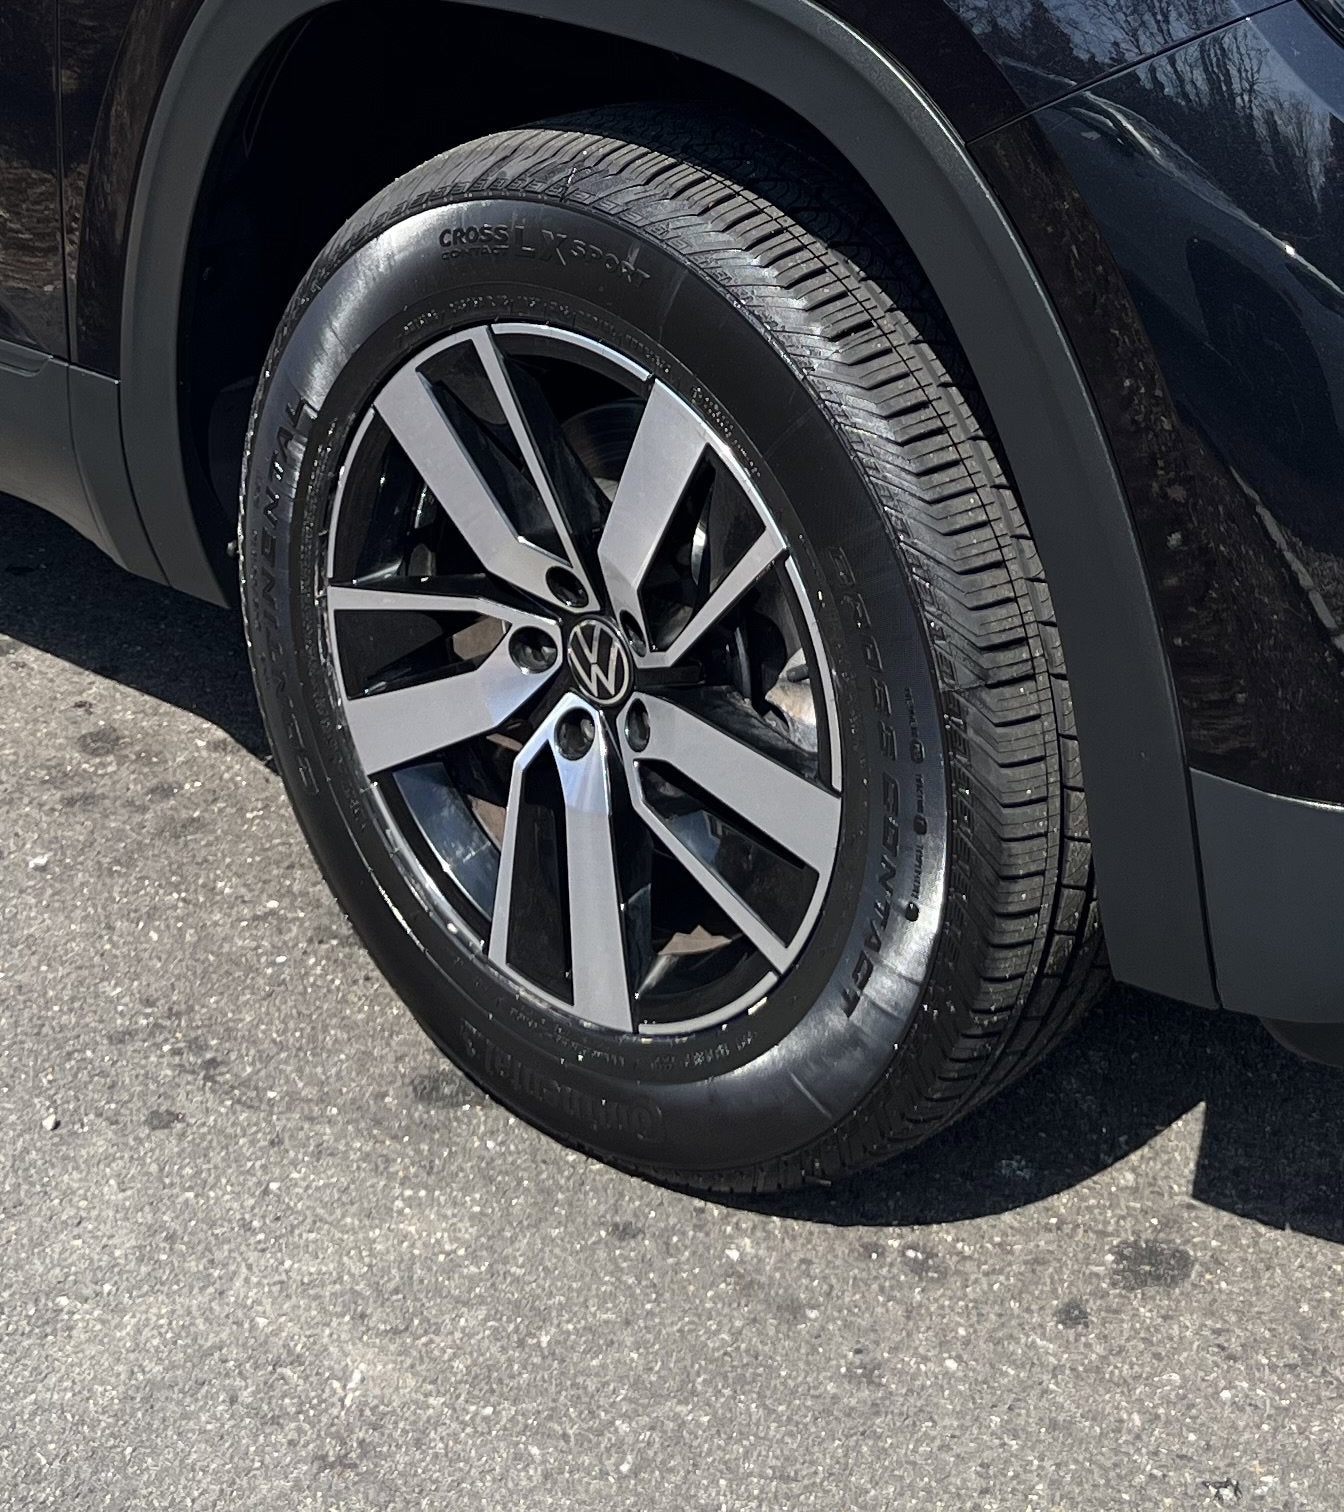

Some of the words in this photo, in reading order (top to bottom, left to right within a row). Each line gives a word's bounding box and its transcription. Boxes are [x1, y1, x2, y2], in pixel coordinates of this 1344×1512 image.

[439, 224, 509, 248] CROSS
[570, 239, 651, 285] SPORT
[567, 620, 623, 701] VW
